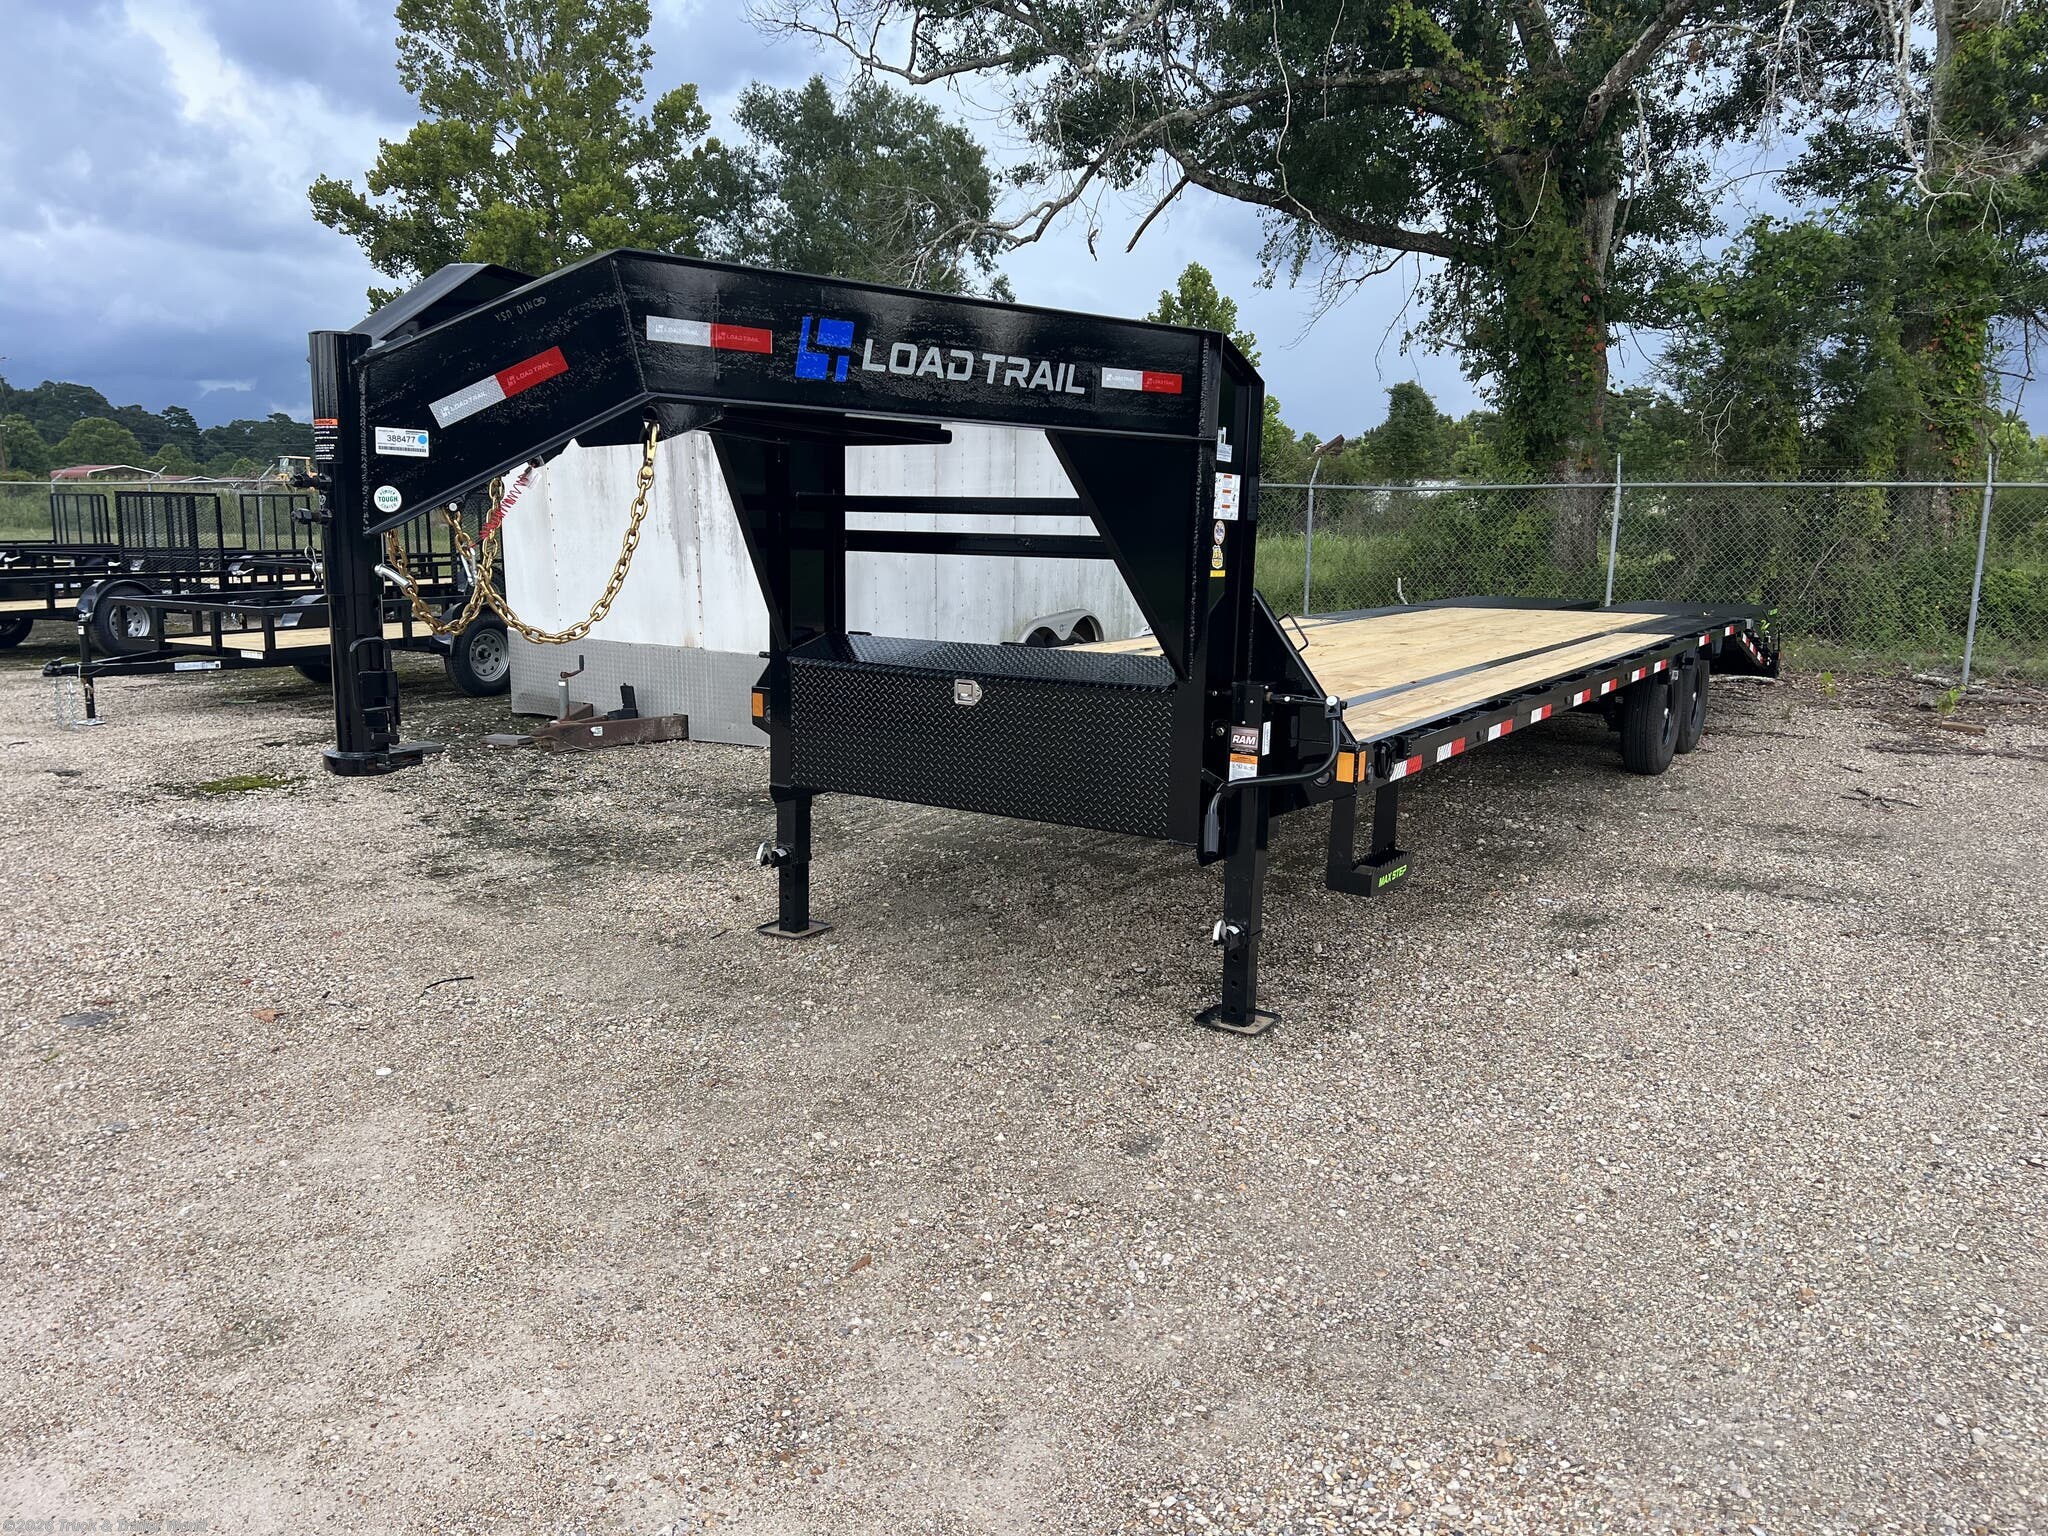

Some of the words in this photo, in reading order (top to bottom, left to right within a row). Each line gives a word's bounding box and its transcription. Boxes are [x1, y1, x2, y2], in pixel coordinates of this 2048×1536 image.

[386, 434, 416, 444] 388477
[1232, 734, 1256, 746] RAM
[1378, 872, 1392, 888] MAX
[1391, 864, 1407, 881] STEP
